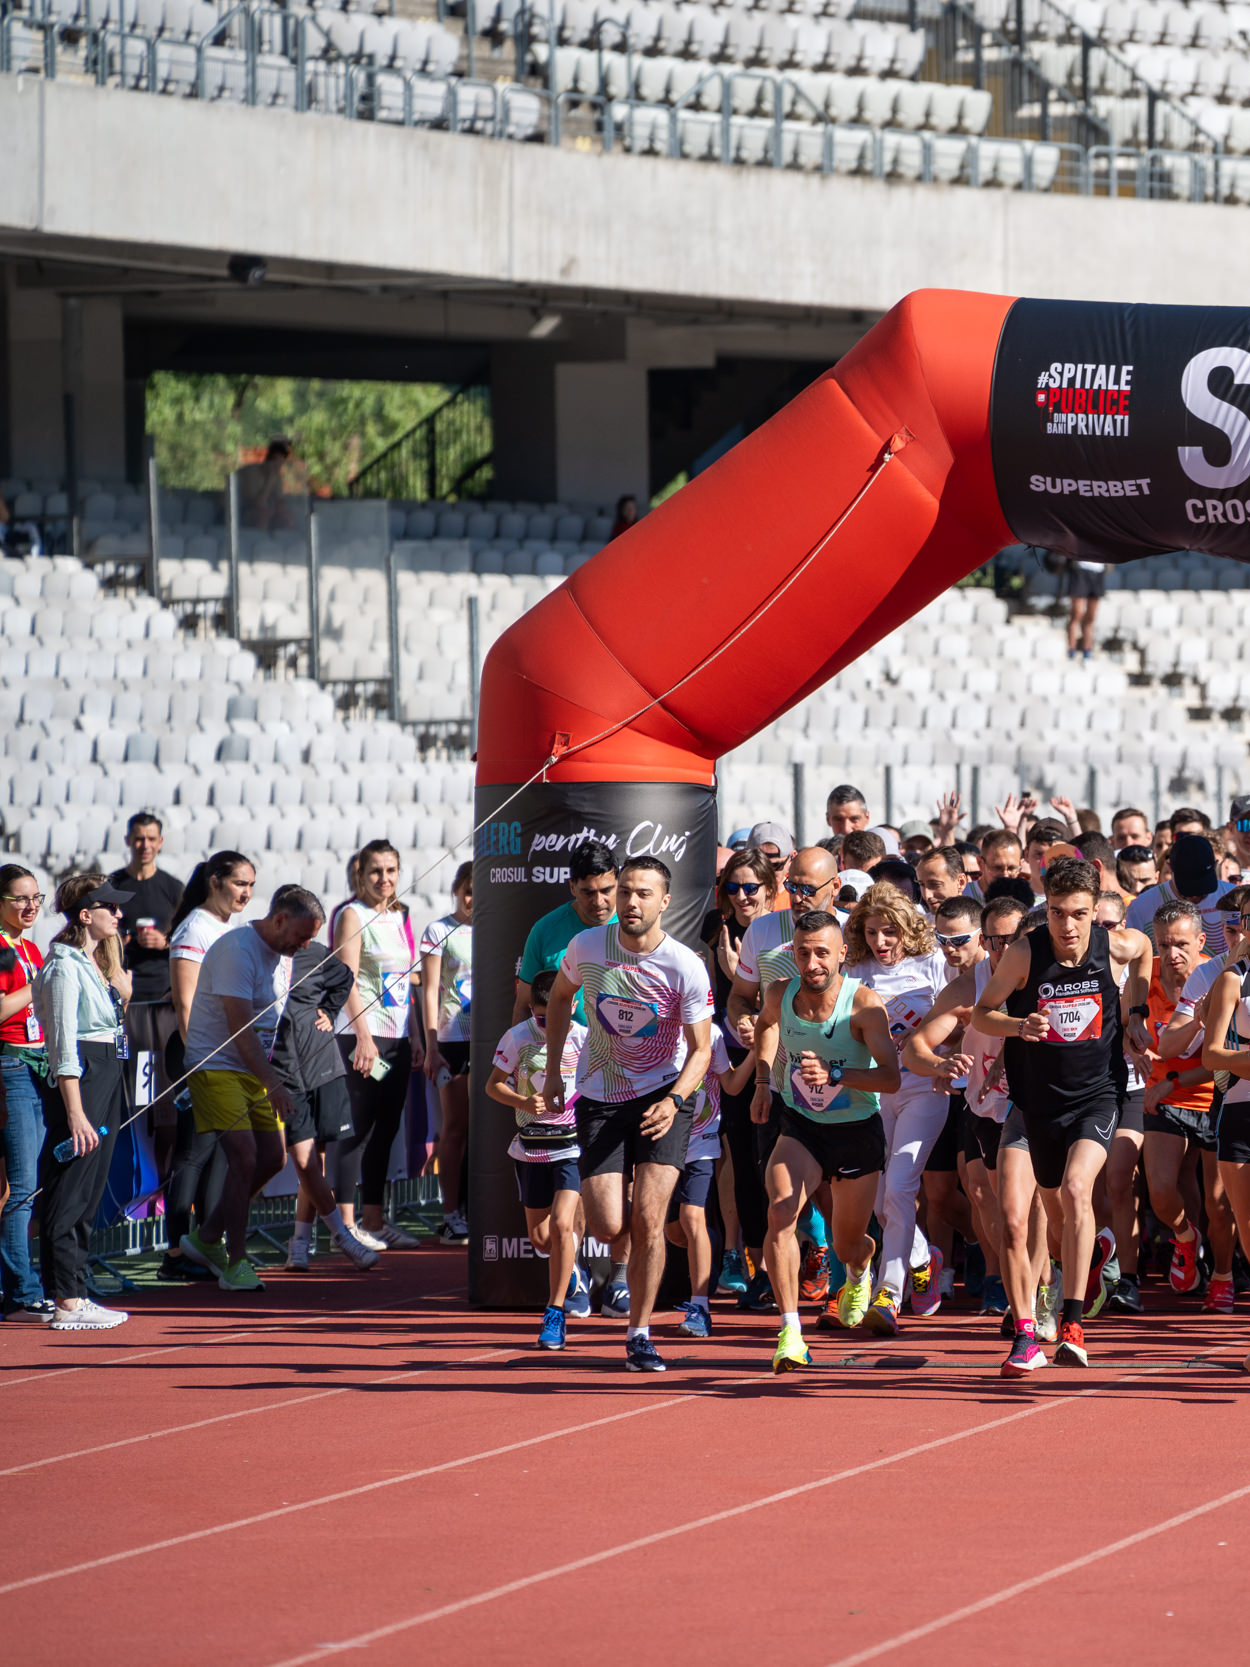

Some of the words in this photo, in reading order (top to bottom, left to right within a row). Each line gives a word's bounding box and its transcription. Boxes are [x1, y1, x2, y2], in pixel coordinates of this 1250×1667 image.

[1037, 362, 1133, 390] #SPITALE
[1049, 388, 1131, 415] PUBLICE
[1053, 412, 1066, 423] DIN
[1067, 413, 1129, 436] PRIVATI
[1047, 423, 1066, 434] BANI
[1029, 475, 1151, 497] SUPERBET
[626, 820, 691, 862] Cluj
[490, 867, 527, 883] CROSUL
[531, 866, 571, 884] SUP
[1056, 980, 1099, 992] AROBS
[618, 1009, 634, 1022] 812
[1059, 1011, 1081, 1024] 1704
[808, 1084, 824, 1095] 912
